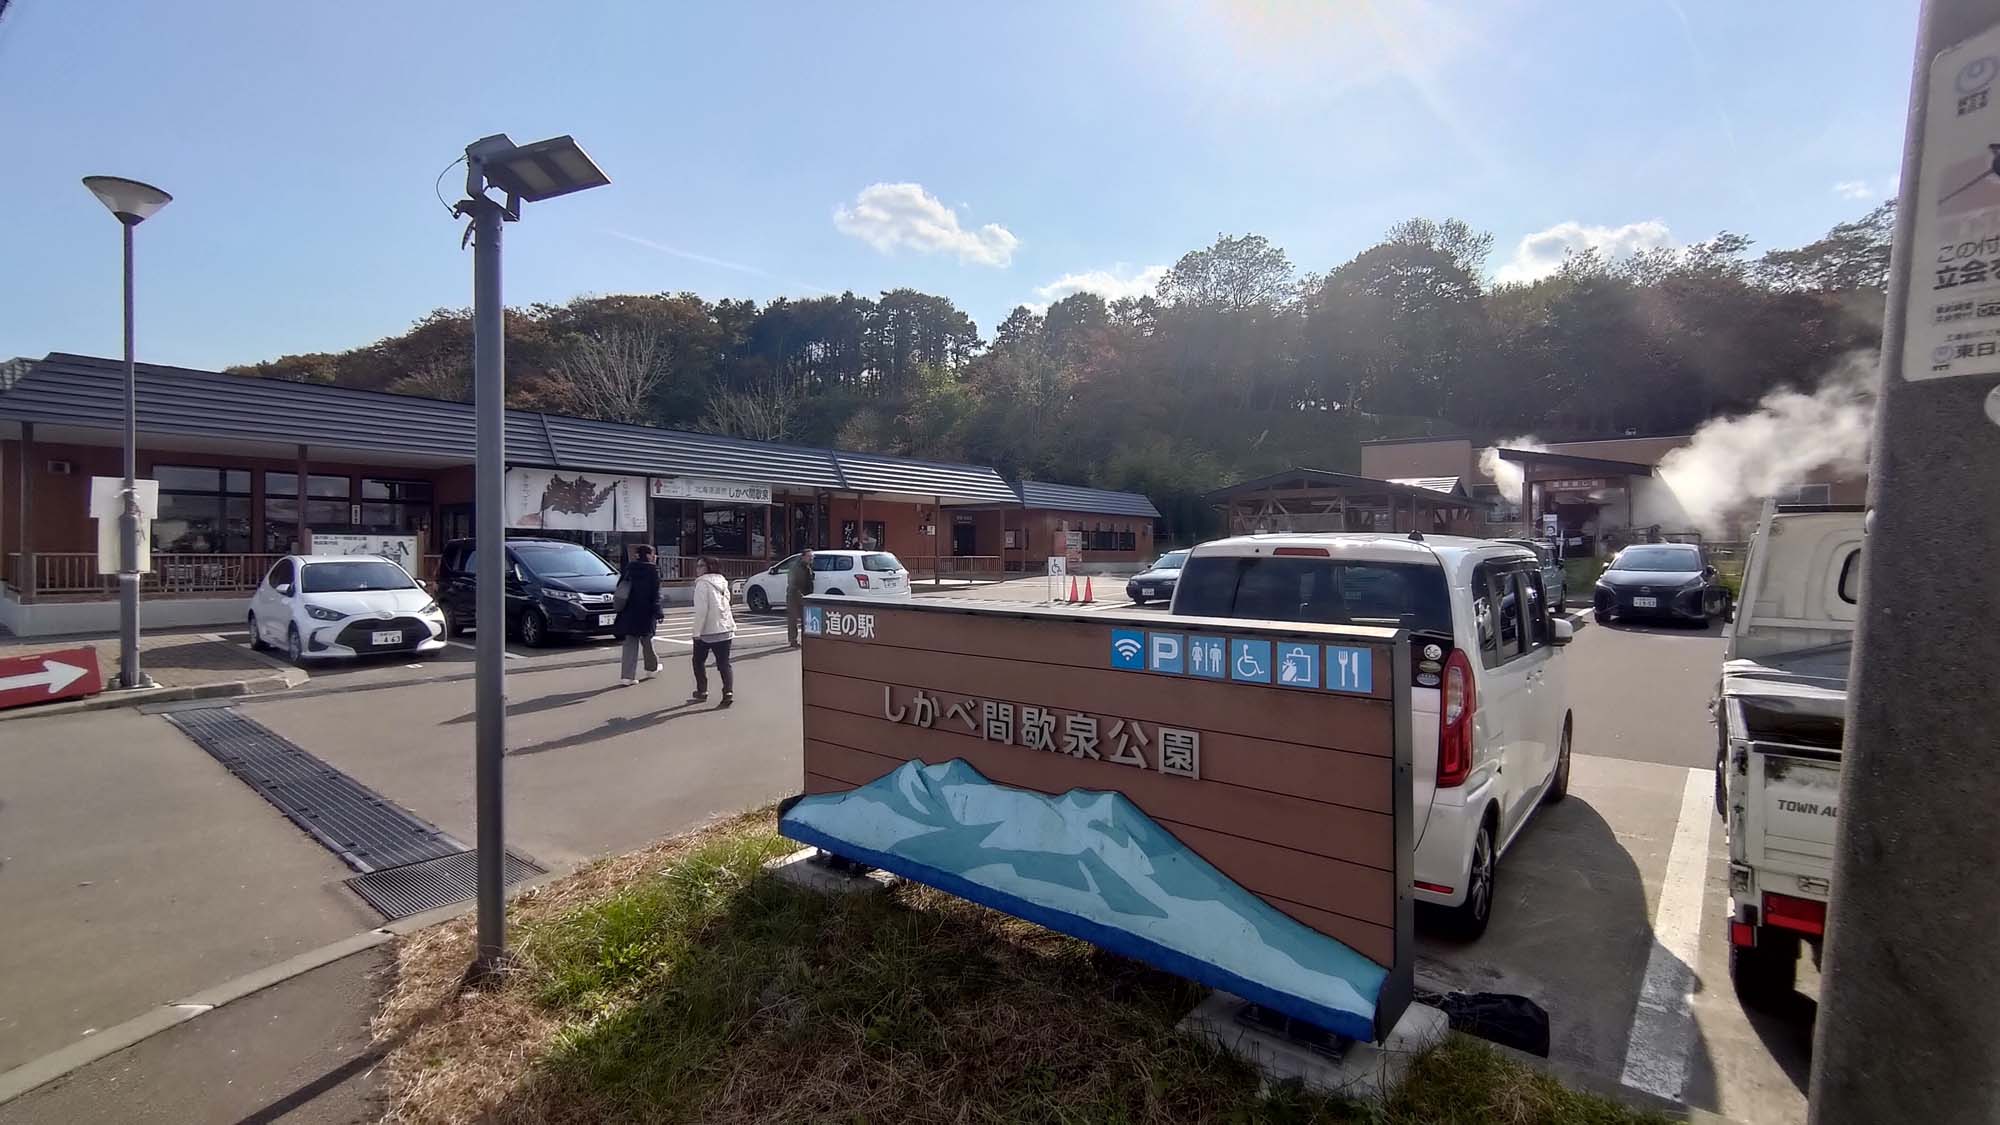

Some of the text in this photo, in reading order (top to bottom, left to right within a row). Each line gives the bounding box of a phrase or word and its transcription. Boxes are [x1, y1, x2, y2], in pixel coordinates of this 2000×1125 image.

[1954, 341, 2000, 359] 東日
[825, 611, 875, 638] 道の駅
[1152, 636, 1178, 669] P
[883, 685, 1200, 780] しかべ間歇泉公園
[1777, 799, 1819, 815] TOWN
